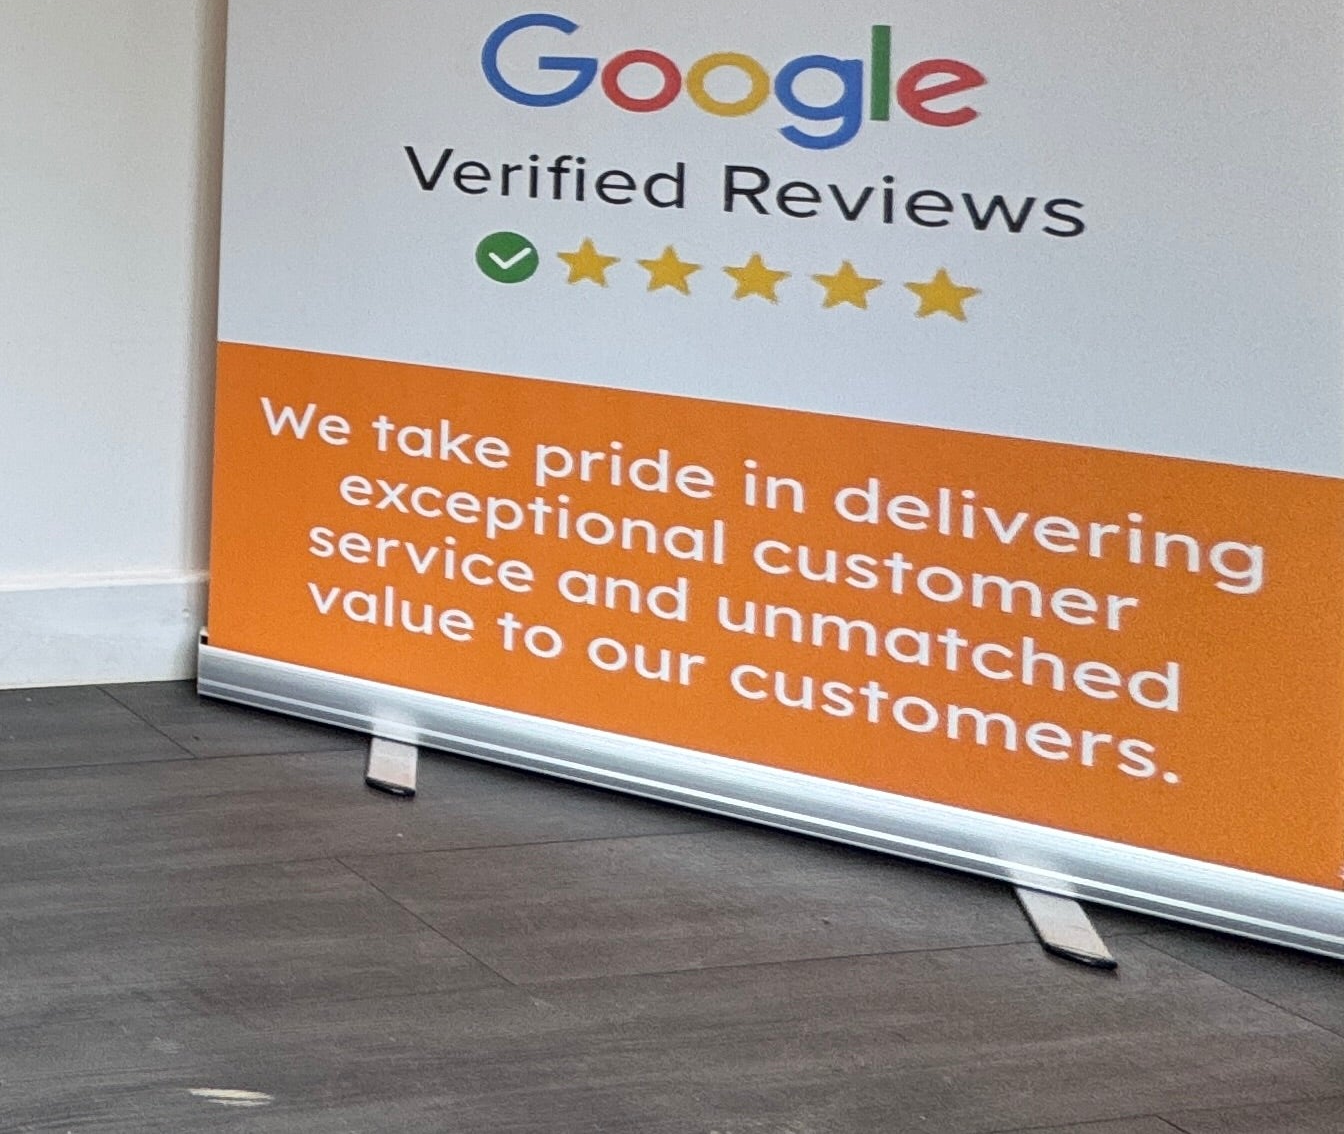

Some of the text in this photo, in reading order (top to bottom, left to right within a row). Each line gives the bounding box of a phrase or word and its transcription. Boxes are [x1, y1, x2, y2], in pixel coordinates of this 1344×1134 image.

[481, 13, 987, 150] Google
[404, 145, 1086, 238] Verified Reviews
[260, 396, 1267, 595] We take pride in delivering
[339, 475, 1139, 631] exceptional customer
[307, 582, 1180, 784] value to our customers.
[309, 526, 1181, 712] service and unmatched
